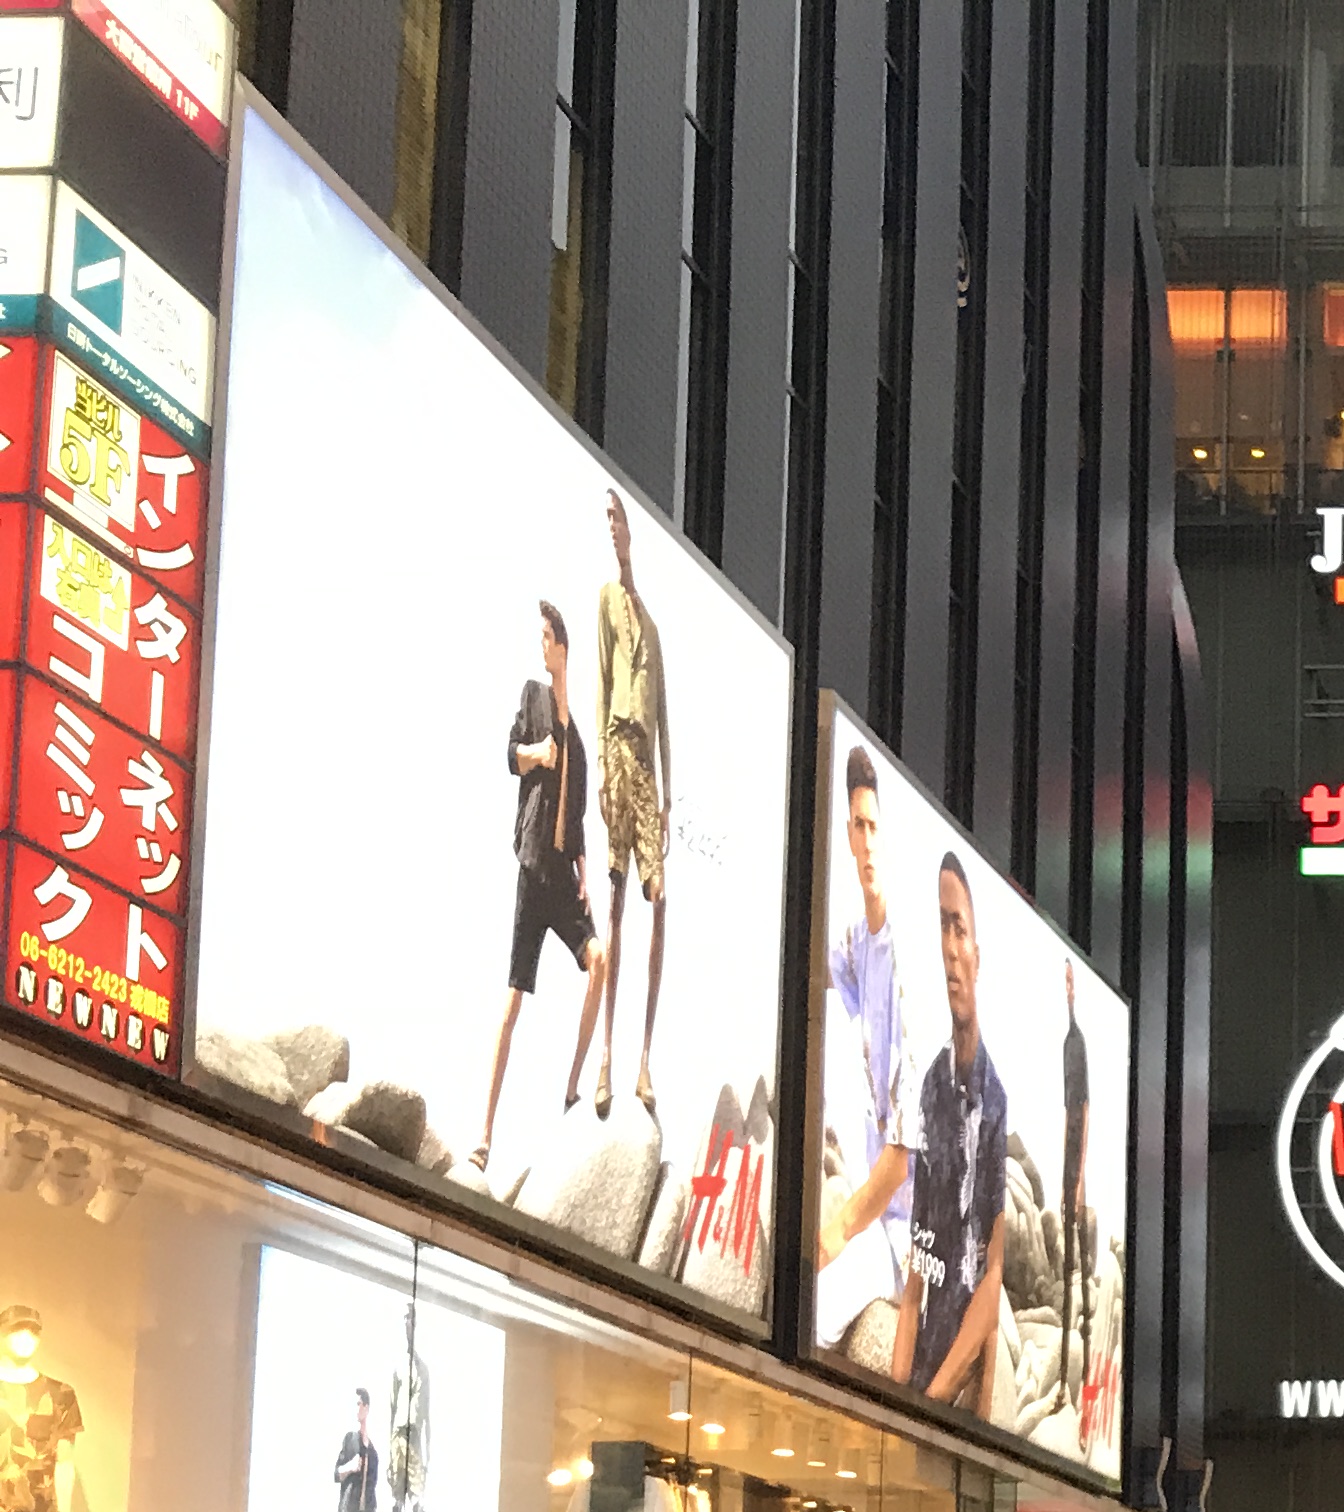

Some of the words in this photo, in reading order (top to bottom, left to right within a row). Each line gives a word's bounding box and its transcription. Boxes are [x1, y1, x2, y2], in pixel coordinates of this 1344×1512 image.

[60, 406, 131, 507] 5F
[73, 375, 123, 442] 当ビル
[34, 614, 105, 943] コミック
[119, 453, 195, 983] インターネット
[20, 931, 128, 1003] 06-6212-2423
[683, 1122, 765, 1279] H&M
